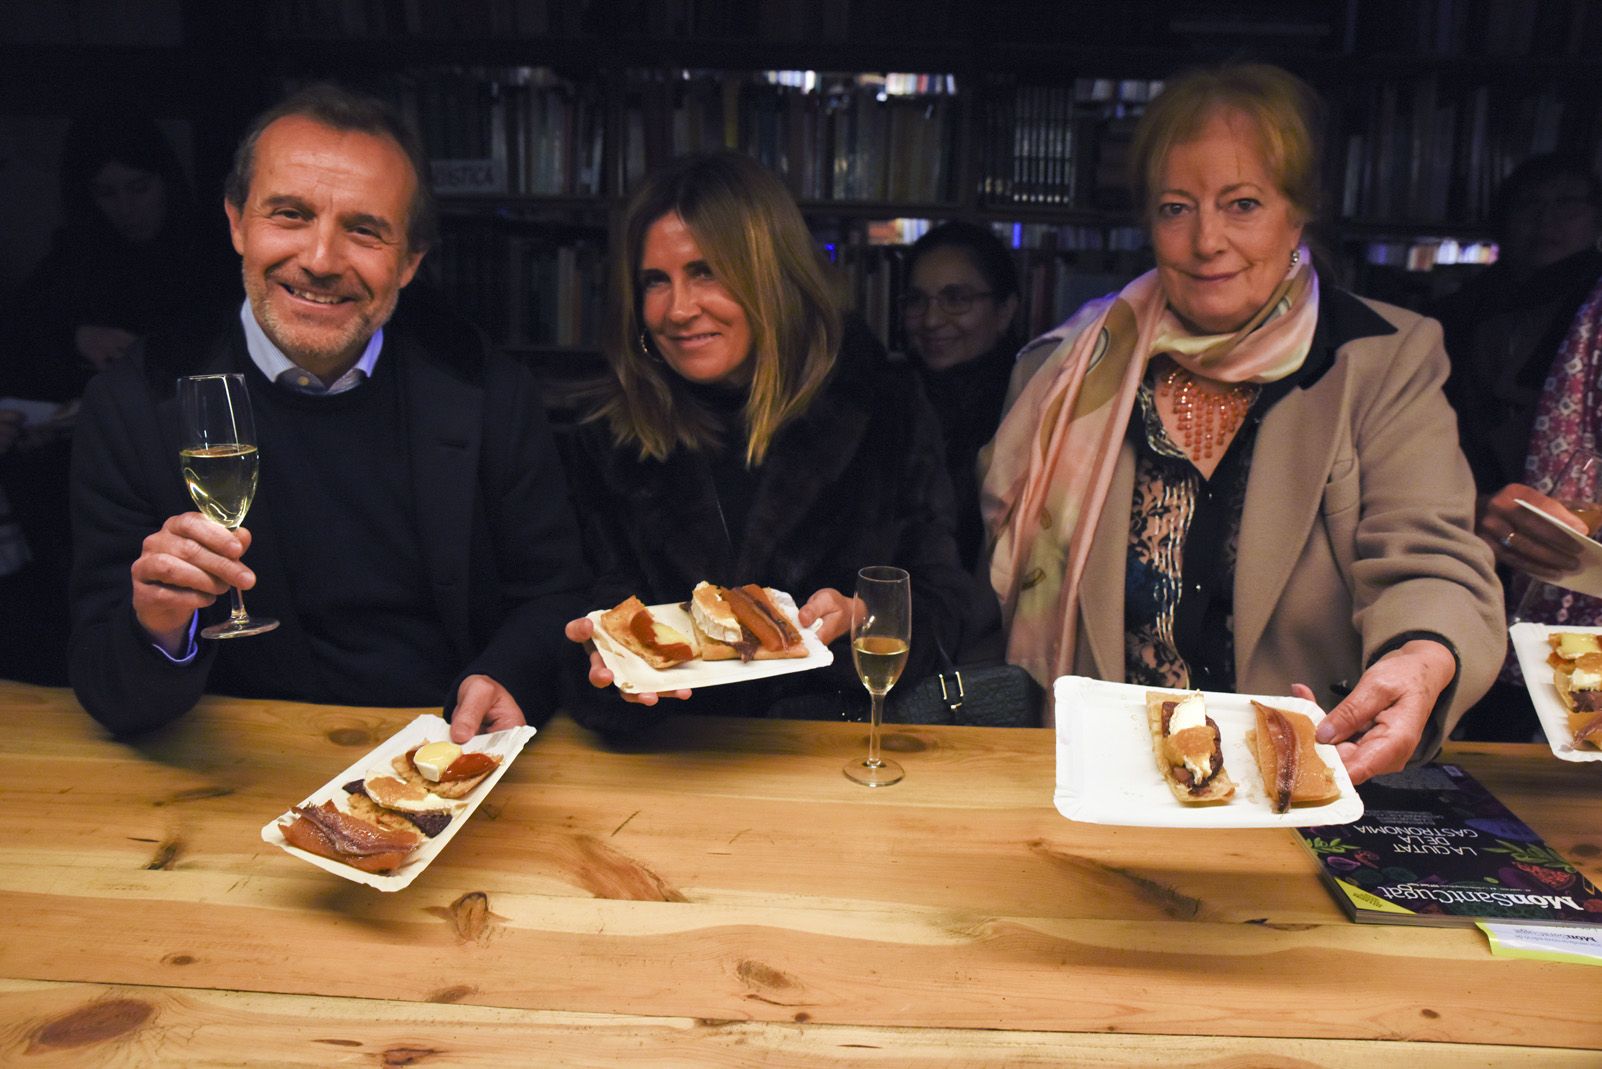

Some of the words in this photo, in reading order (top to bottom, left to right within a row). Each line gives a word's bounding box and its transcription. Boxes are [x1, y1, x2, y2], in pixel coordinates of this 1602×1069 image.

[1353, 825, 1478, 838] GASTRONOMIA
[1398, 834, 1426, 845] LA
[1428, 835, 1450, 846] DE
[1393, 842, 1450, 855] CIUTAT
[1451, 845, 1478, 857] LA
